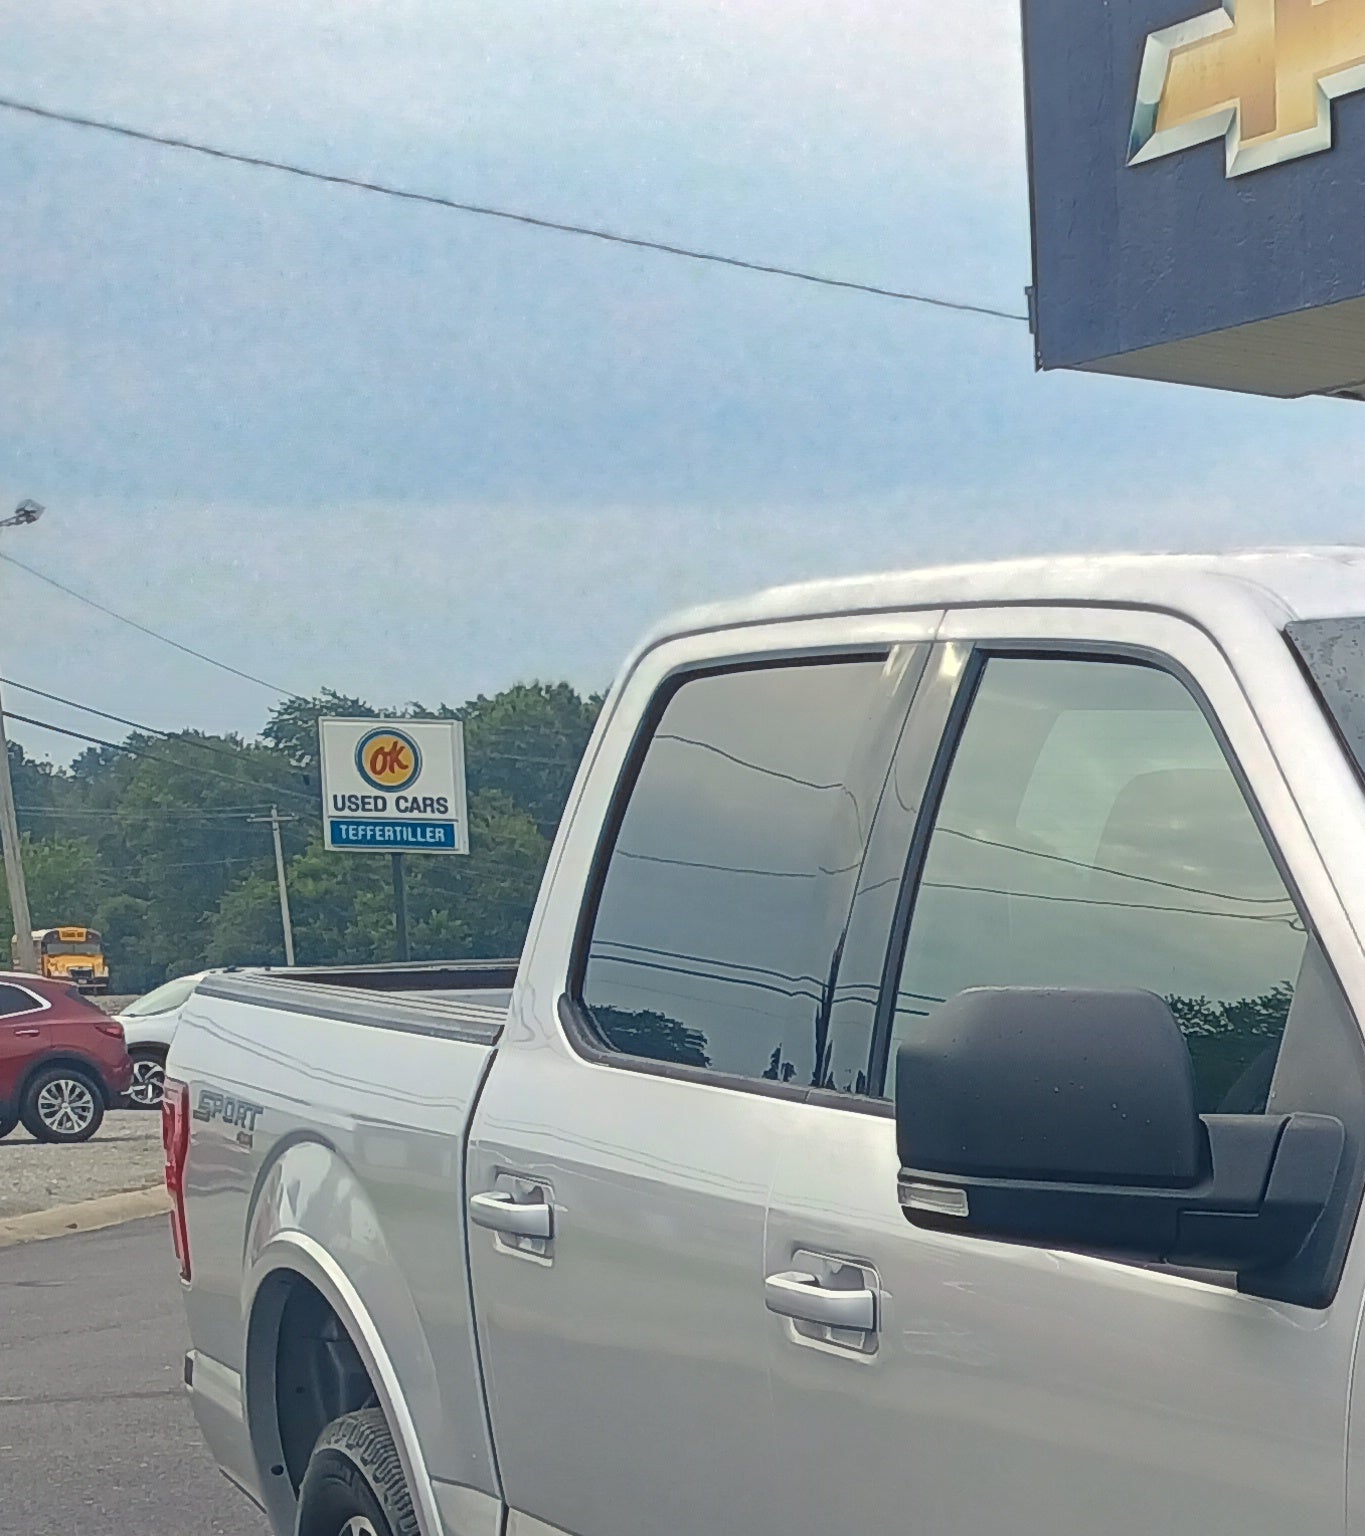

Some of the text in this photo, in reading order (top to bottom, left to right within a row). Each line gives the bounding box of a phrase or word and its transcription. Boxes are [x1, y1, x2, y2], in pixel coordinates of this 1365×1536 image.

[369, 741, 409, 776] OK
[333, 794, 449, 815] USED CARS
[339, 824, 446, 843] TEFFERTILLER
[192, 1089, 264, 1132] SPORT
